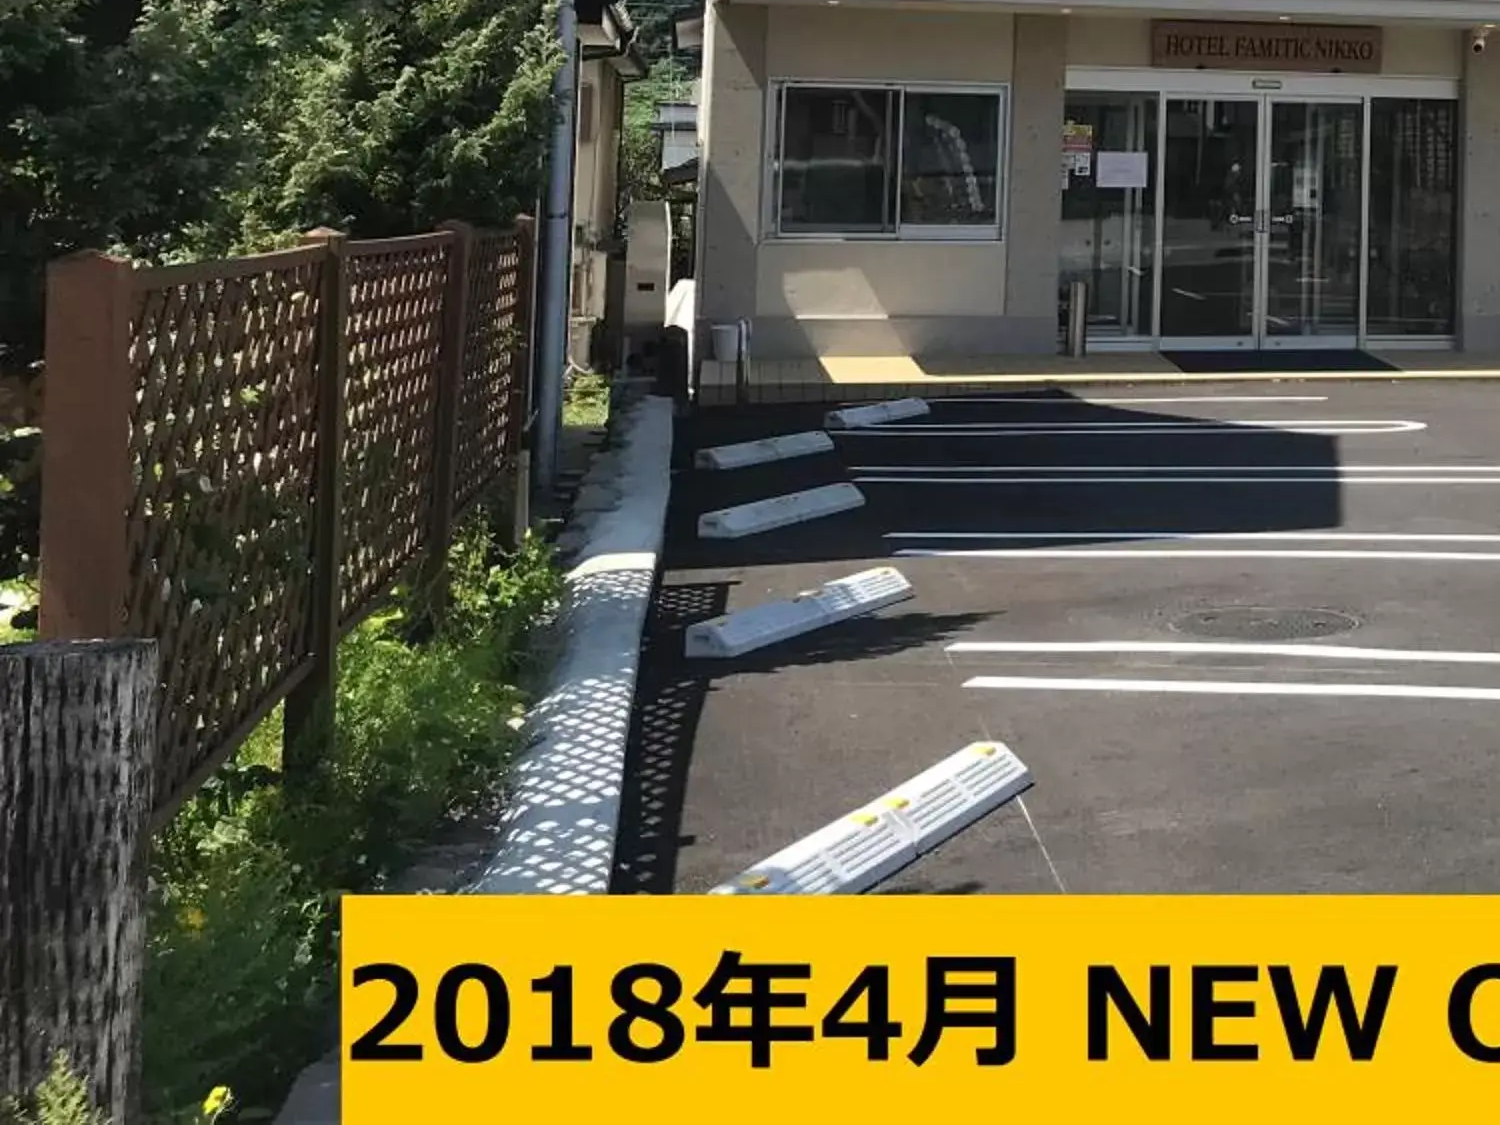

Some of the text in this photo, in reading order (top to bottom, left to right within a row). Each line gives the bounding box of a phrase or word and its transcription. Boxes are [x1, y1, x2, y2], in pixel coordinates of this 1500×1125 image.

[1166, 34, 1373, 60] HOTEL FAMITIC NIKKO
